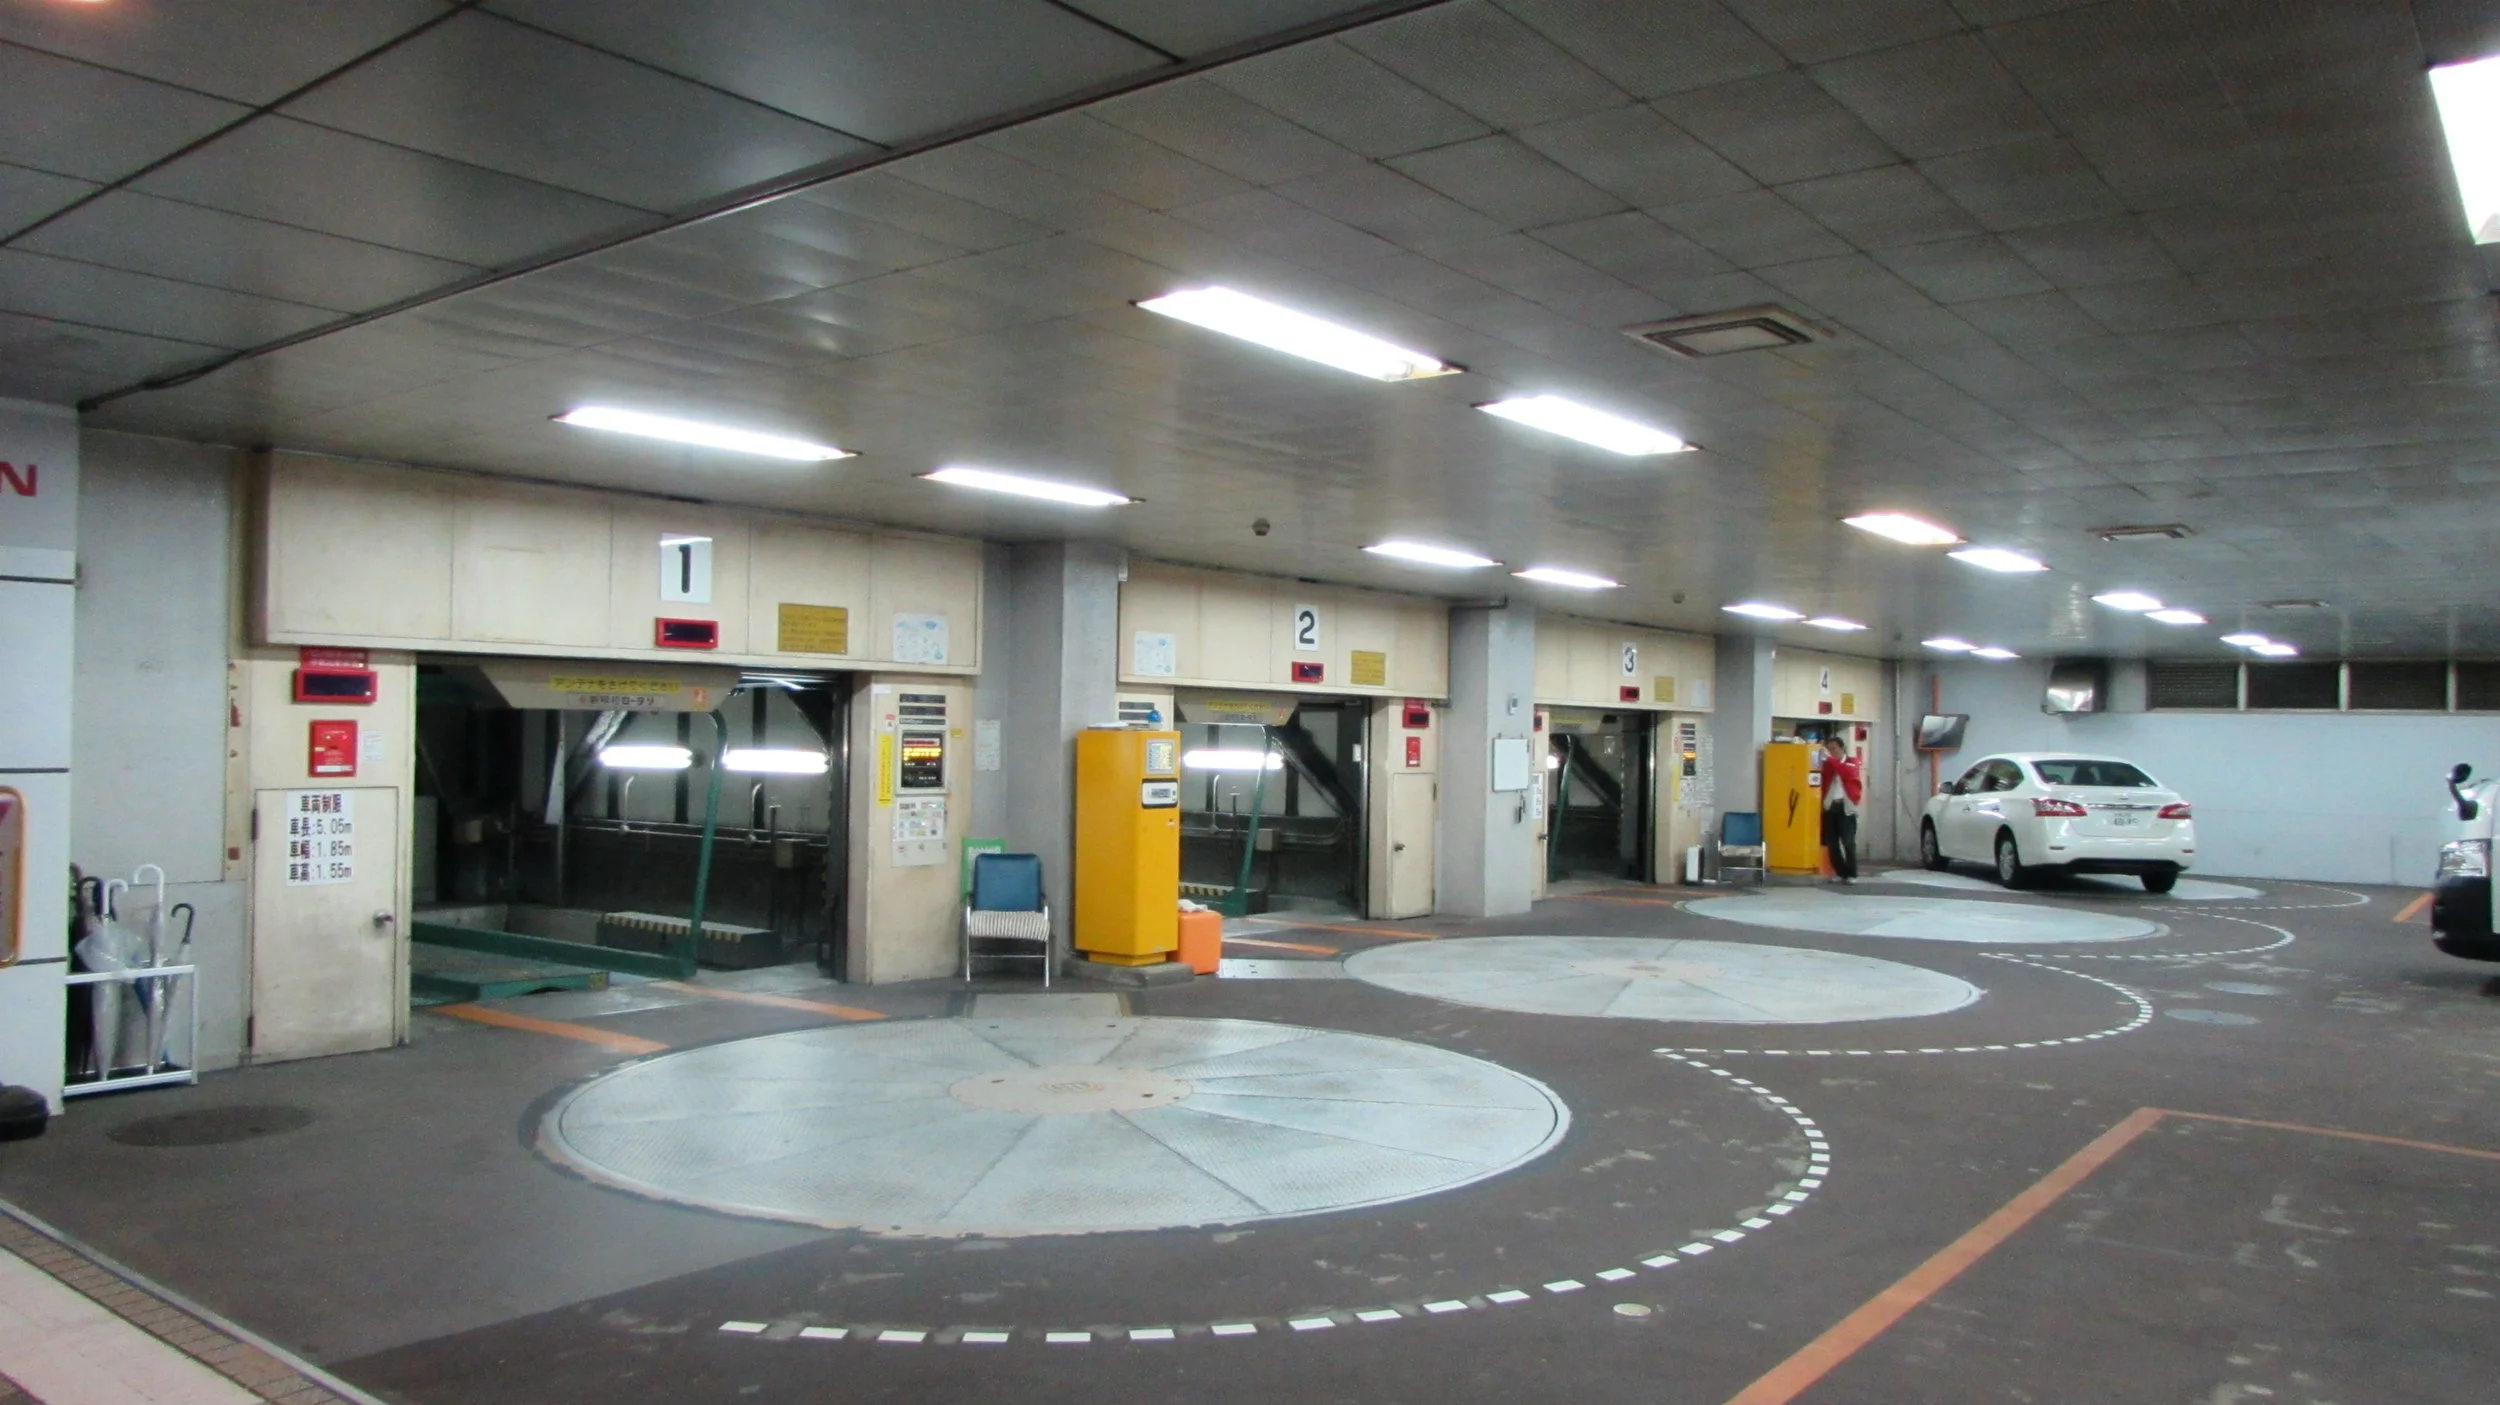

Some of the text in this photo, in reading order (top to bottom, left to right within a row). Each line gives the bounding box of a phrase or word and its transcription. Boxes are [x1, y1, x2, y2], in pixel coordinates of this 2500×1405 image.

[679, 543, 691, 593] 1
[1299, 610, 1315, 644] 2
[1624, 646, 1634, 673] 3
[1821, 669, 1828, 691] 4
